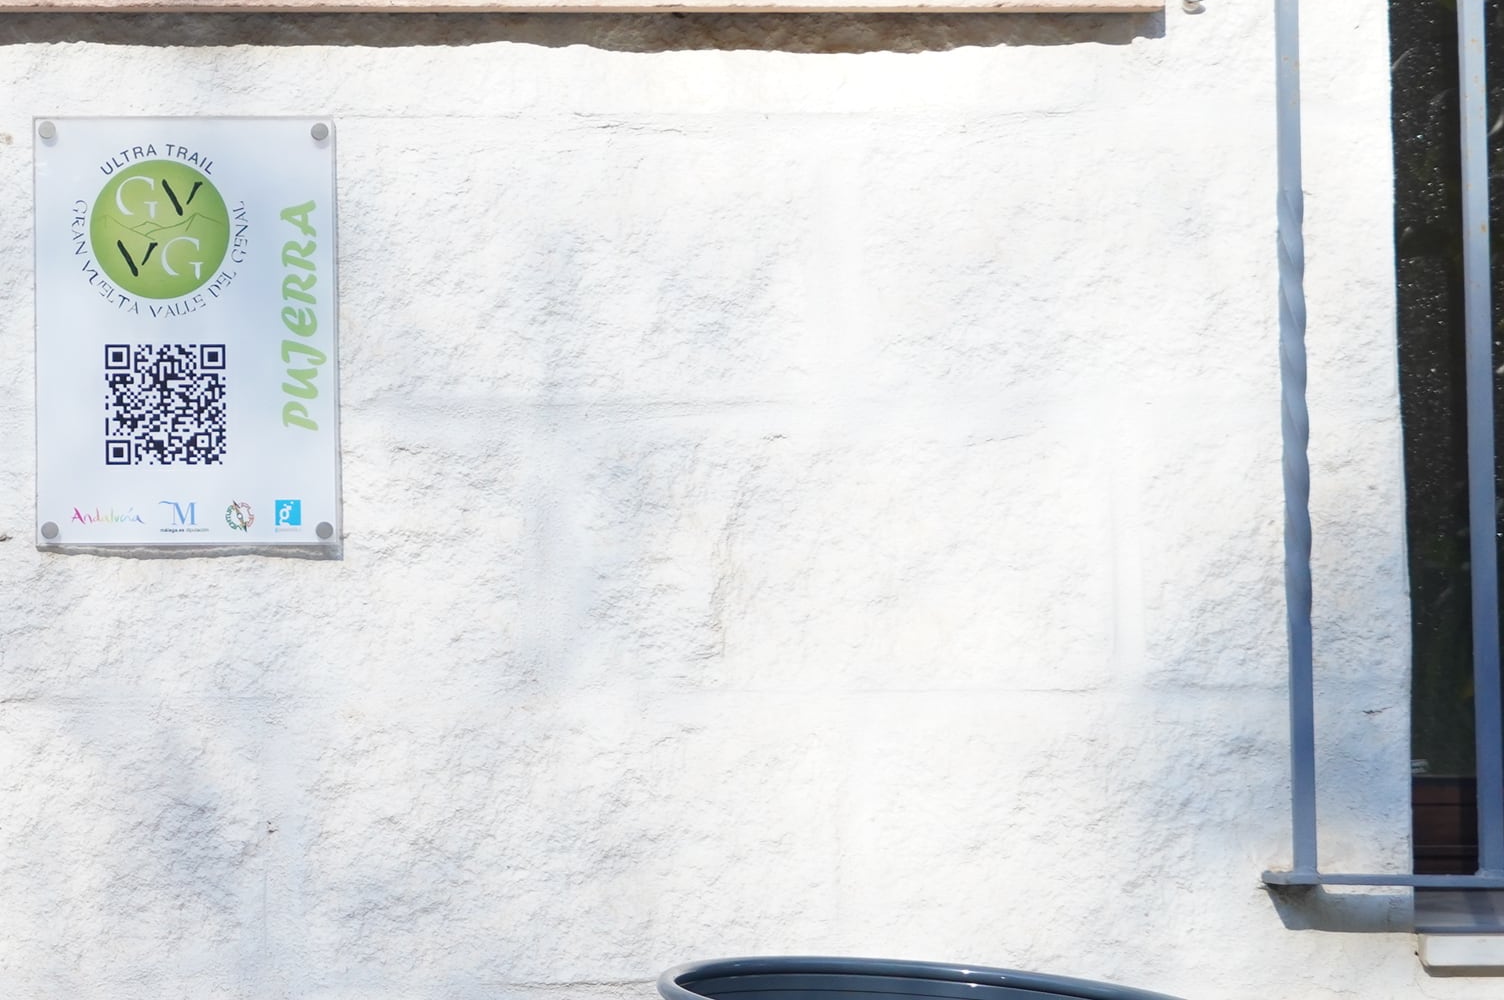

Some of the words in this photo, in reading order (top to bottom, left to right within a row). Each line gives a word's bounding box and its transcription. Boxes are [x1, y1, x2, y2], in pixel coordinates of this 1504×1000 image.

[100, 143, 157, 175] ULTRA
[165, 143, 214, 175] TRAIL
[71, 200, 88, 256] GRAN
[82, 260, 139, 315] VUELTA
[149, 294, 207, 318] VALLE
[207, 271, 237, 299] DEL
